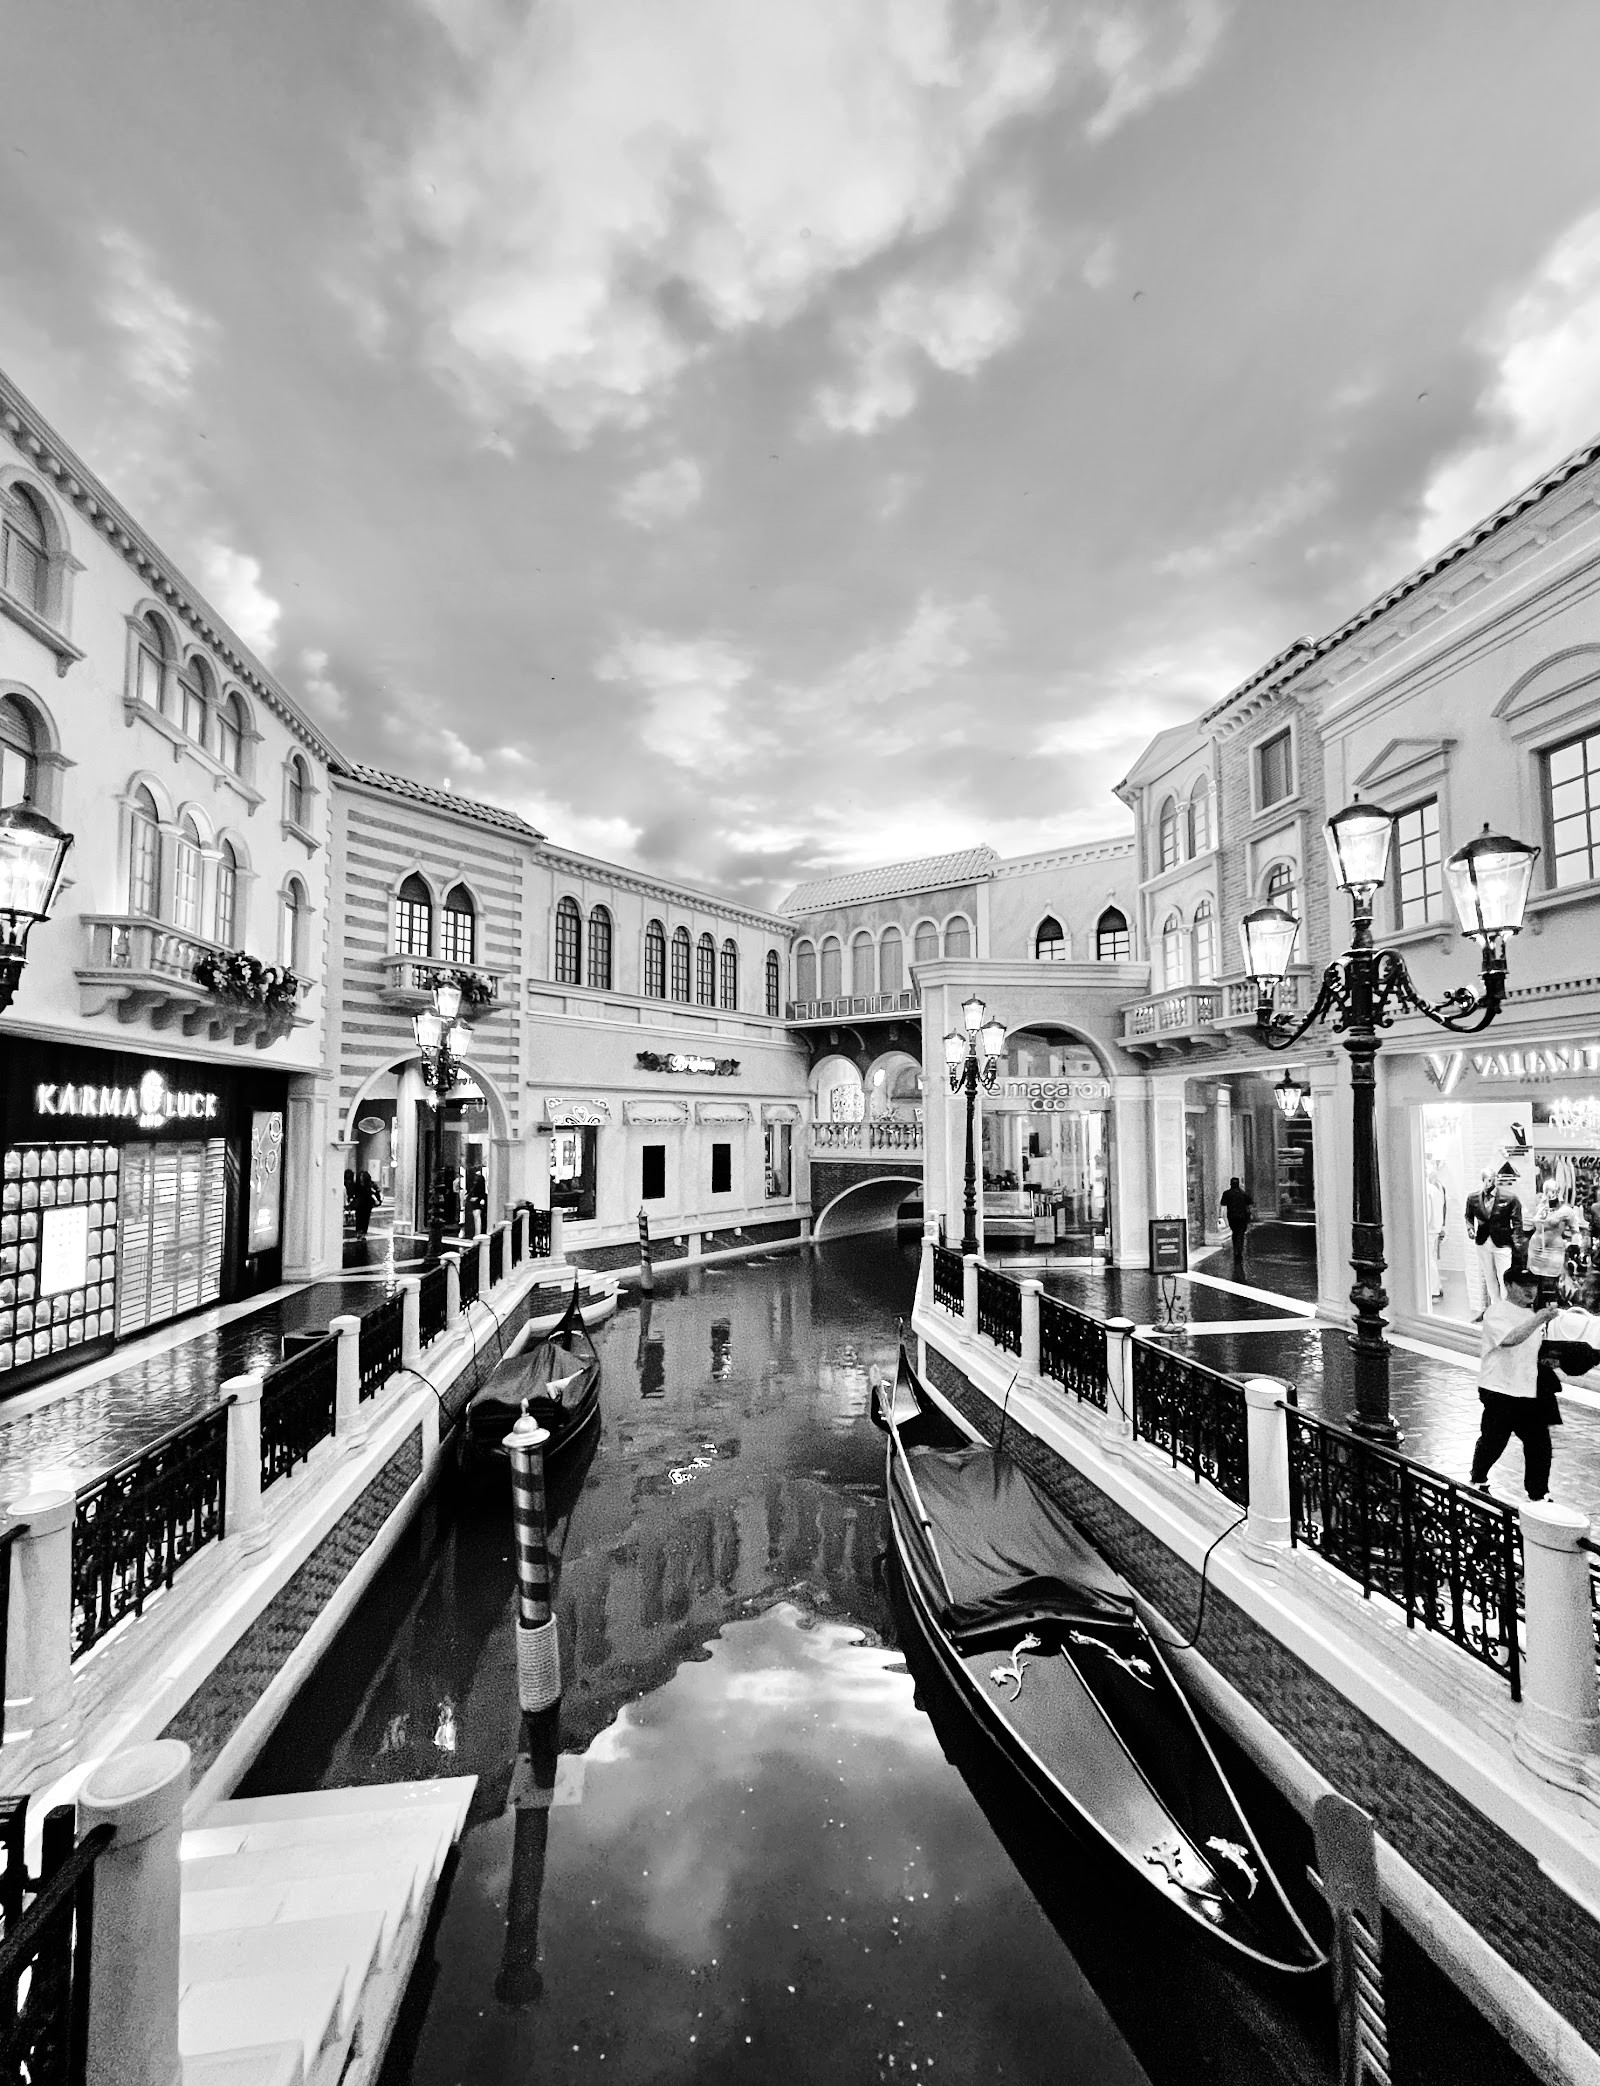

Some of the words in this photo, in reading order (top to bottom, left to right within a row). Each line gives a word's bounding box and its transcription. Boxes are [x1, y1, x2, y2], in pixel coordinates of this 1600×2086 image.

[37, 1083, 138, 1117] KARMA
[165, 1091, 218, 1118] LUCK
[1003, 1081, 1111, 1099] macaron
